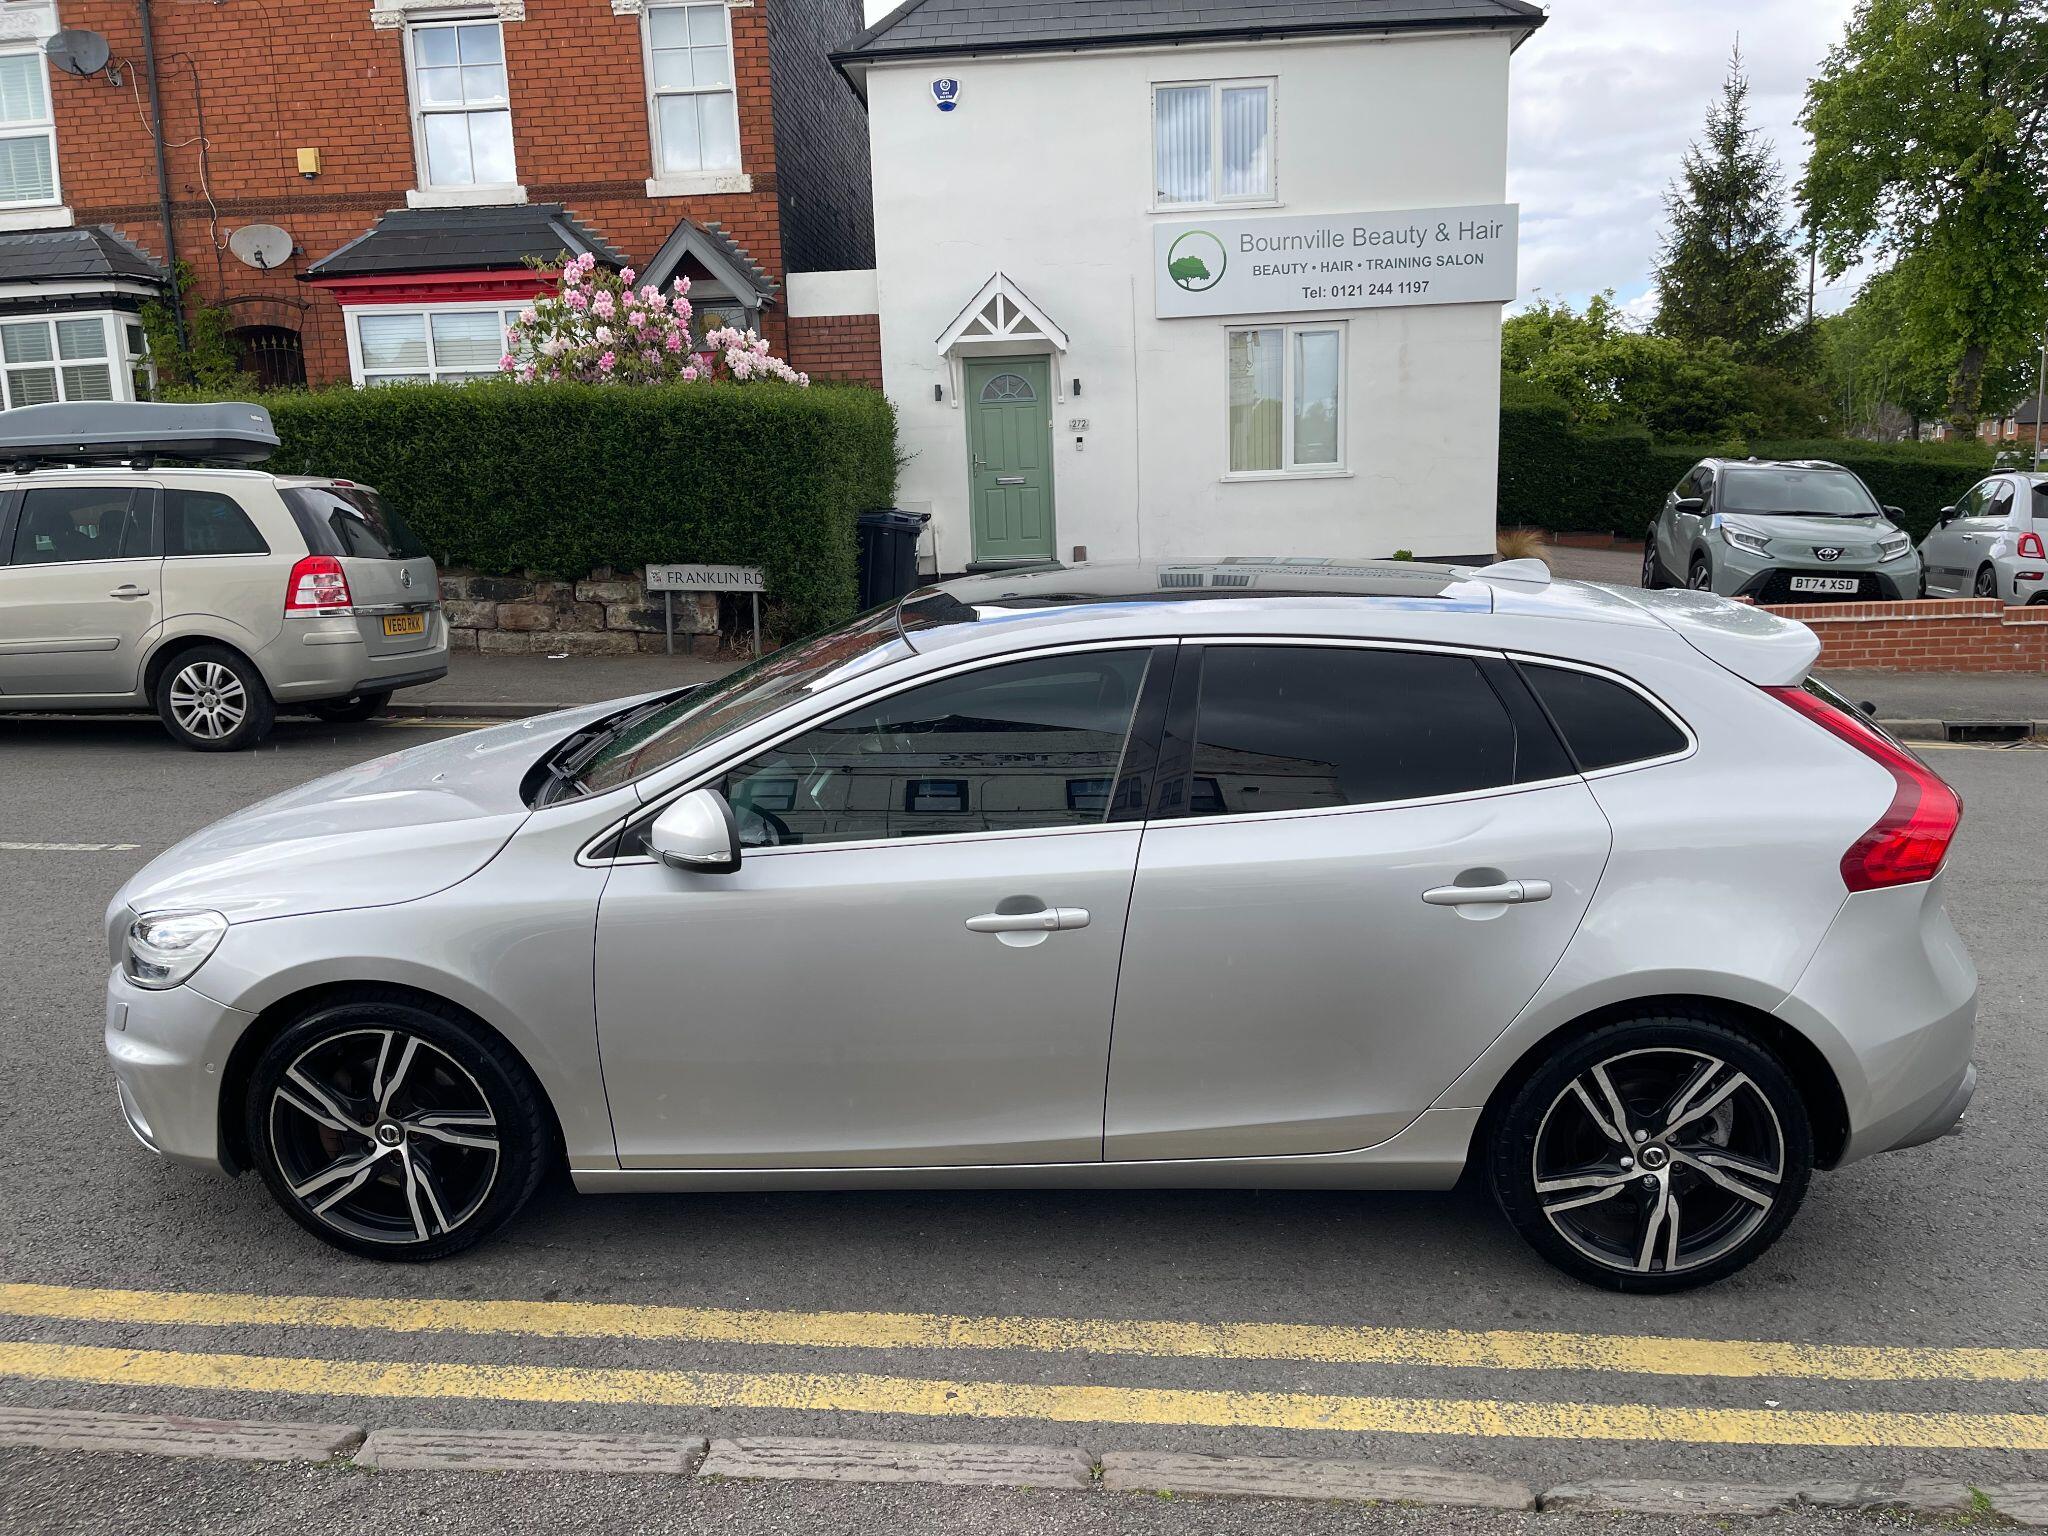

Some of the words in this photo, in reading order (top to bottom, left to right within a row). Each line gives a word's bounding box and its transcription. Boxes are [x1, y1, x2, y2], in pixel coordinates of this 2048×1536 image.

[1240, 230, 1344, 253] Bournville
[1353, 225, 1428, 249] Beauty
[1435, 222, 1450, 242] &
[1459, 219, 1504, 241] Hair
[1252, 262, 1309, 277] BEAUTY
[1320, 261, 1354, 273] HAIR
[1366, 255, 1432, 271] TRAINING
[1436, 253, 1484, 267] SALON
[1302, 286, 1327, 299] Tel:
[1331, 284, 1364, 298] 0121
[1368, 282, 1393, 296] 244
[1398, 280, 1430, 295] 1197
[1071, 419, 1087, 428] 272
[667, 571, 739, 584] FRANKLIN
[744, 572, 763, 585] RD
[1796, 578, 1826, 589] BT74
[1829, 579, 1853, 590] XSD
